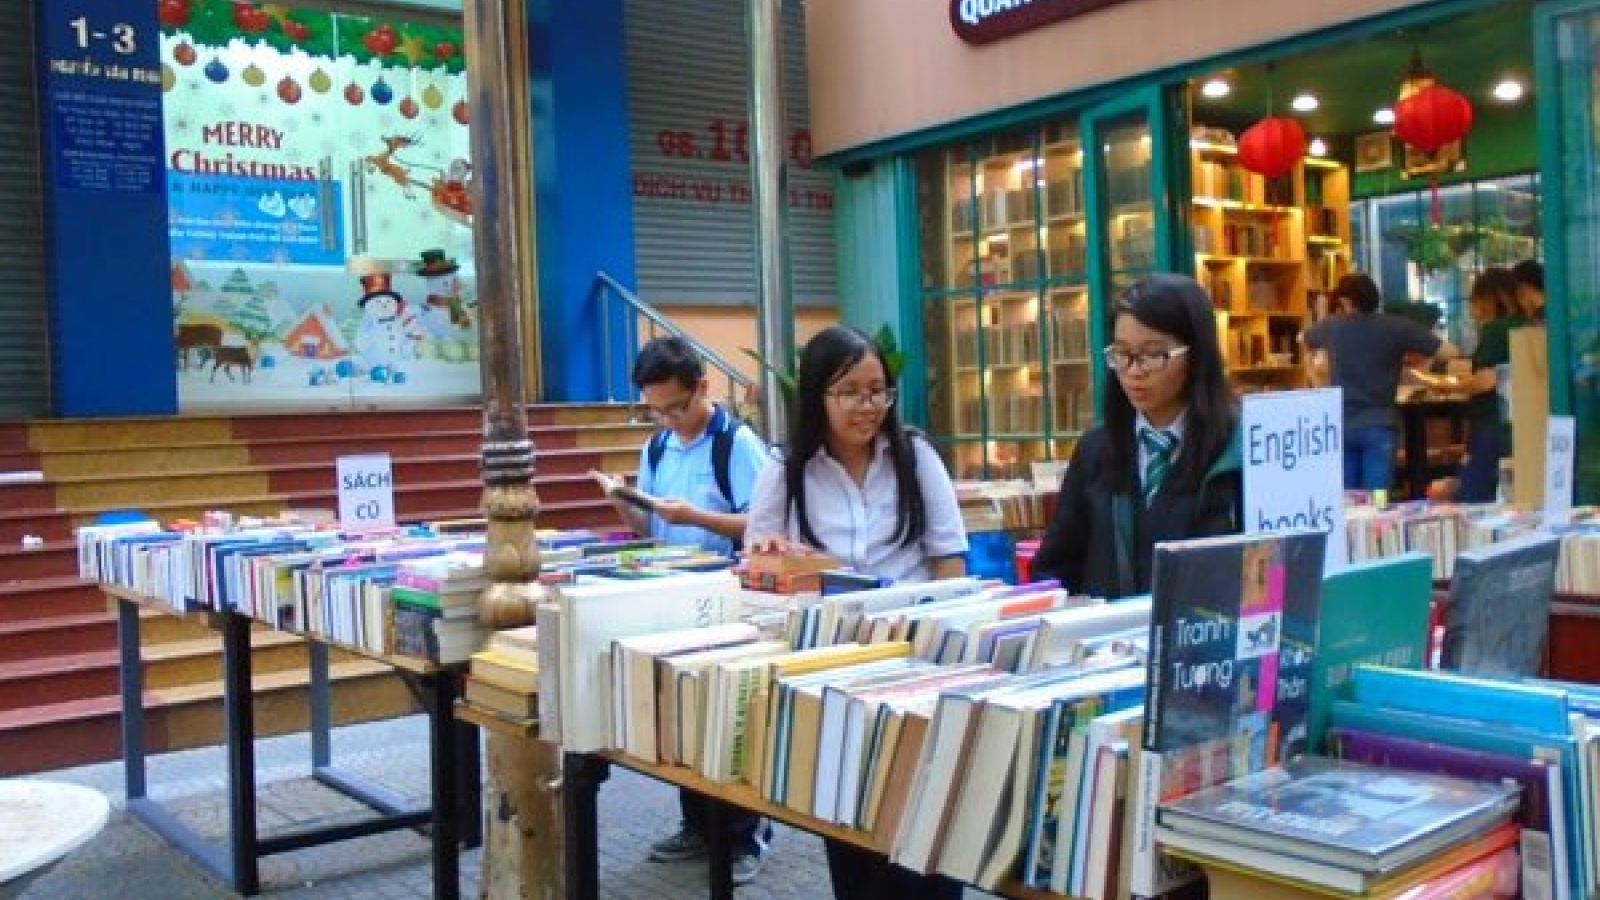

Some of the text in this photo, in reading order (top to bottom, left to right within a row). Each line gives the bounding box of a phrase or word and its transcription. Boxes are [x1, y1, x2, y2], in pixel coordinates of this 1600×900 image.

[202, 121, 285, 150] MERRY
[171, 148, 316, 183] Christmas
[1248, 411, 1340, 471] English
[343, 470, 390, 490] SÁCH
[1174, 615, 1231, 647] Tranh
